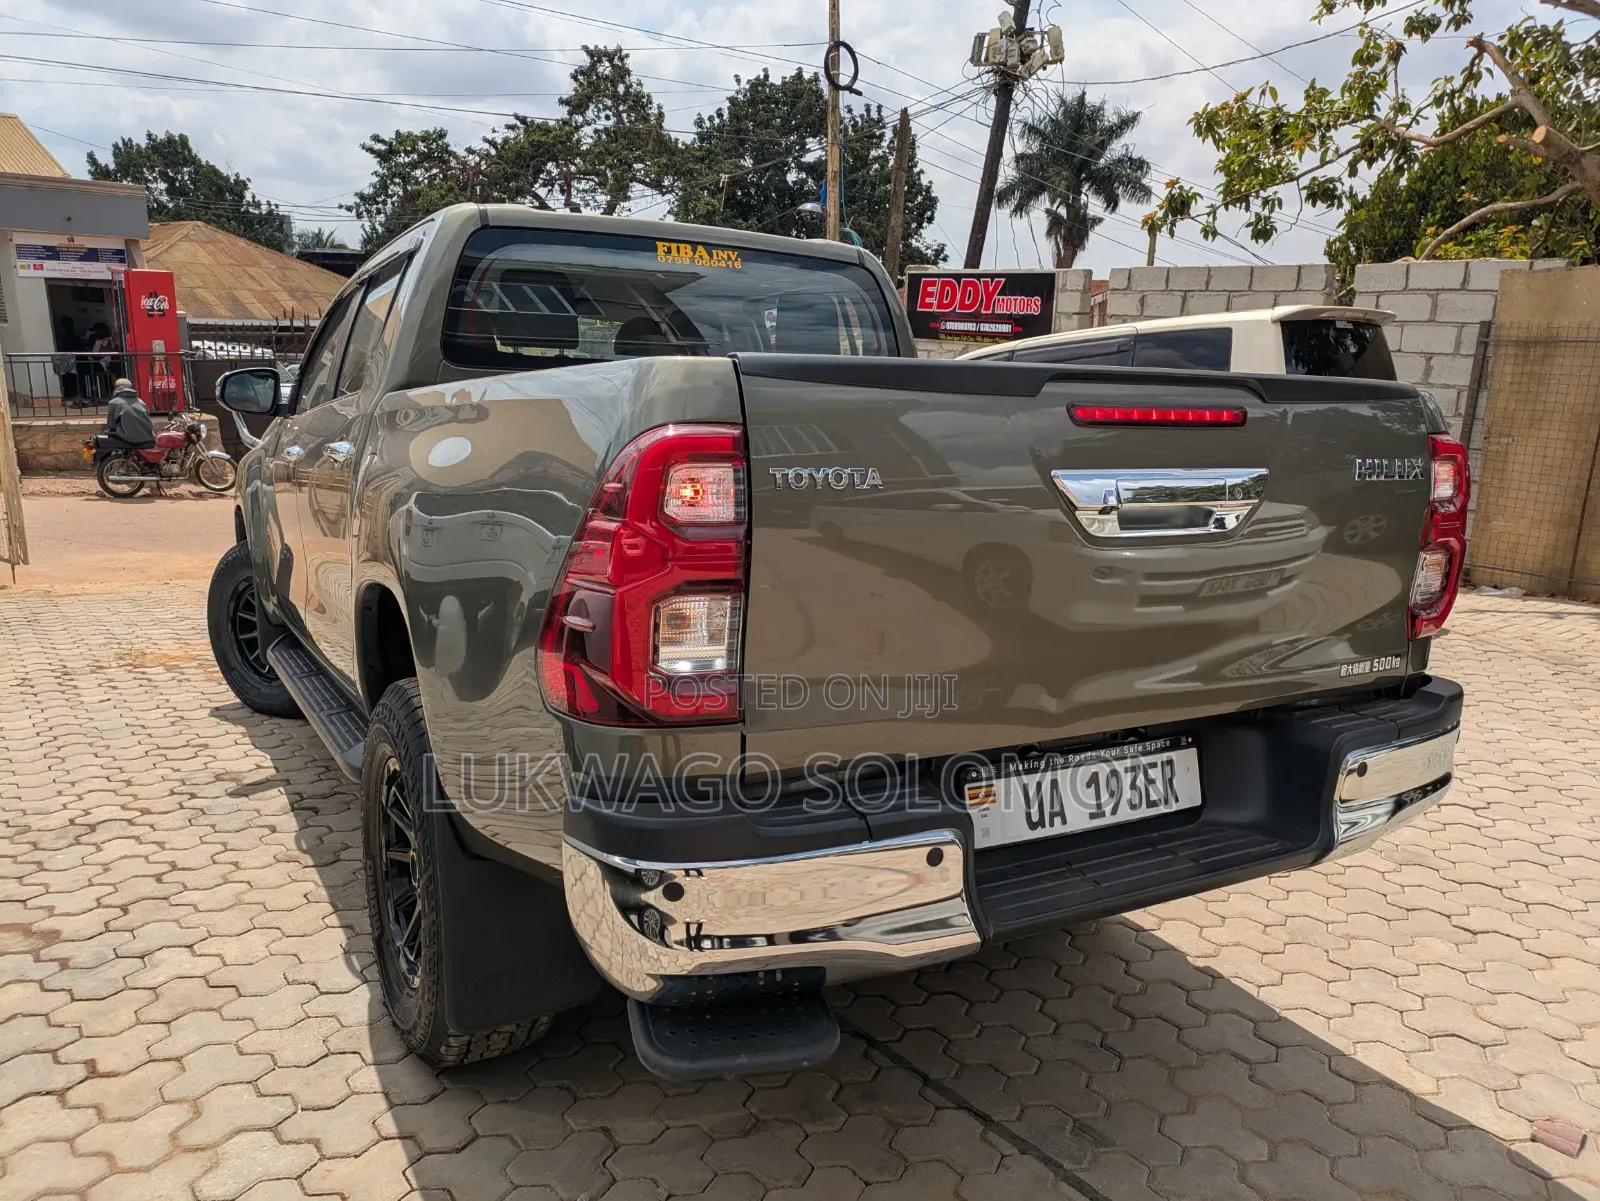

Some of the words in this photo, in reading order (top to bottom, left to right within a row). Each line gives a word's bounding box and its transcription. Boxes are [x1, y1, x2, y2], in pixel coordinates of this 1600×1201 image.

[656, 241, 710, 259] FIBA
[712, 249, 742, 262] INV.
[657, 255, 690, 265] 0759
[694, 258, 742, 269] 060416
[141, 295, 169, 310] Coca-Cola
[917, 278, 1006, 313] EDDY
[995, 295, 1041, 315] MOTORS
[769, 466, 884, 490] TOYOTA
[1353, 458, 1425, 481] HILUX
[1009, 758, 1045, 772] Making
[1050, 756, 1065, 766] the
[1068, 751, 1096, 764] Roads
[1100, 748, 1120, 758] Your
[1124, 744, 1142, 755] Safe
[1146, 740, 1171, 751] Space
[1022, 778, 1067, 831] UA
[1086, 758, 1179, 820] 193ER
